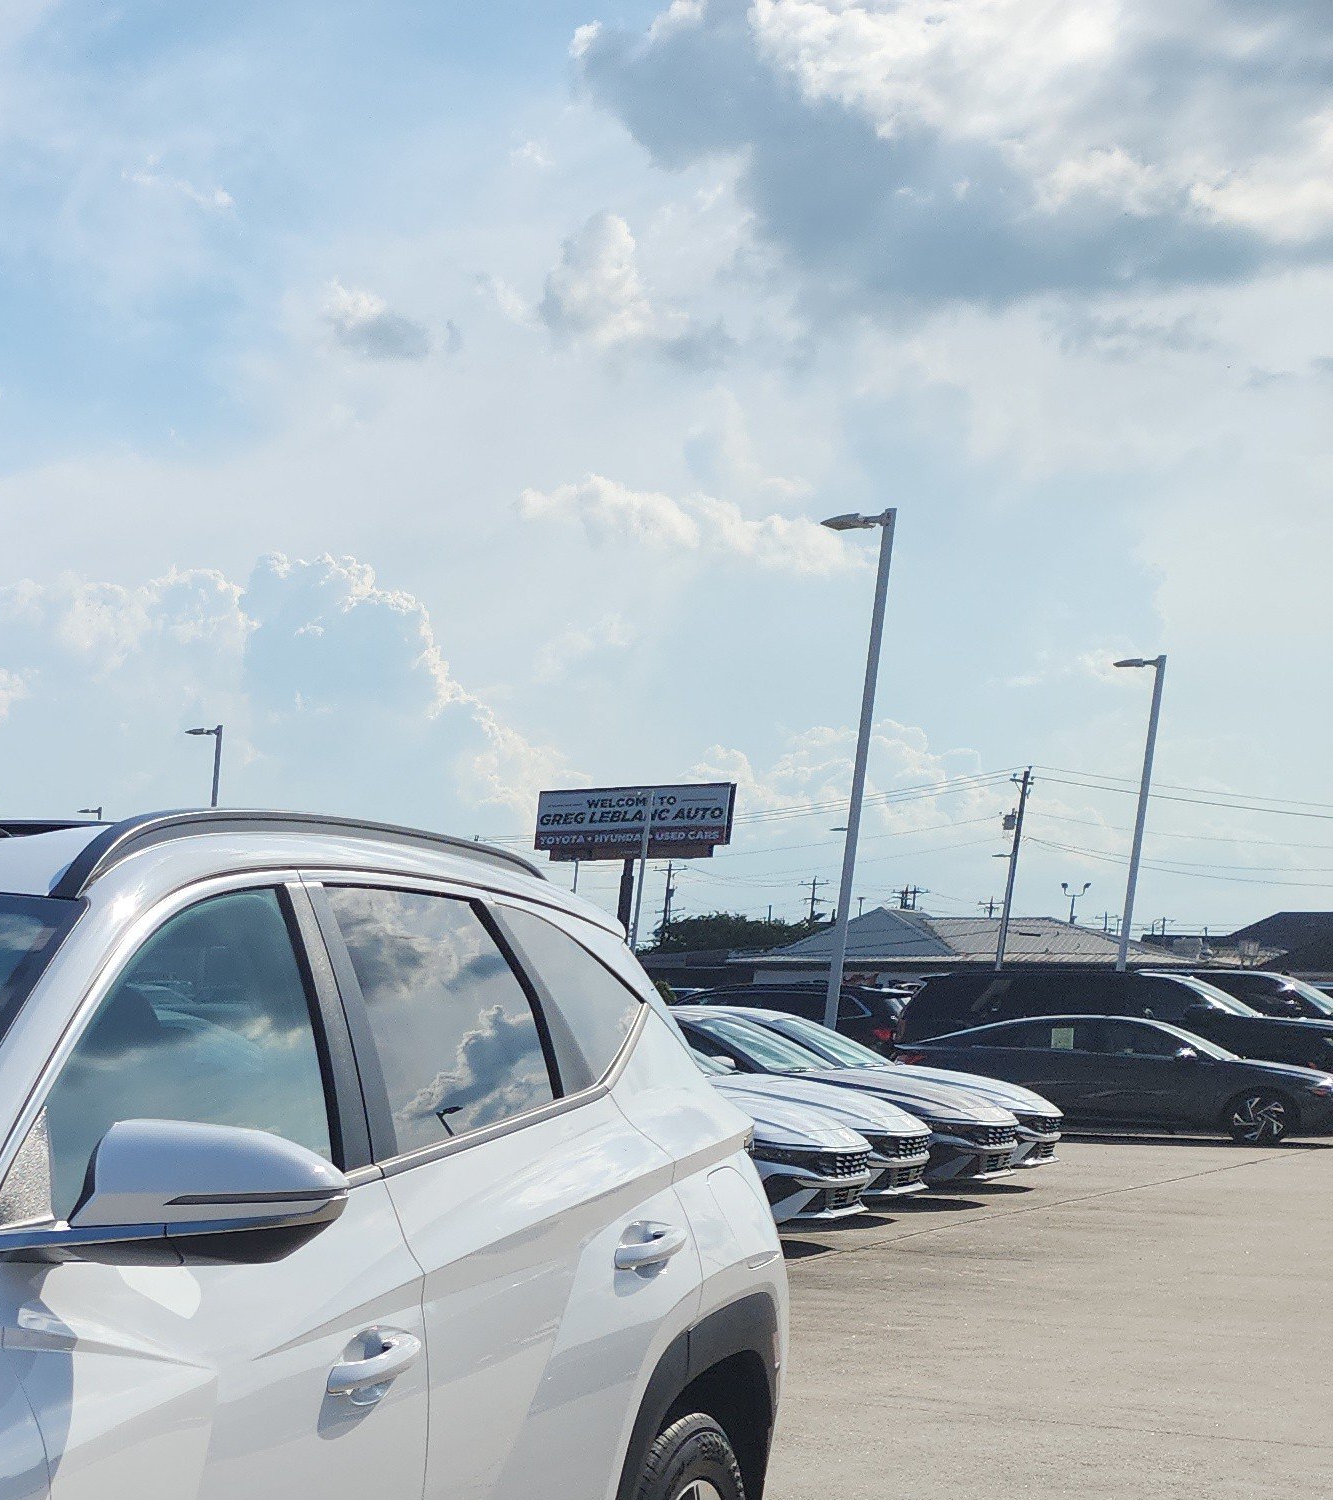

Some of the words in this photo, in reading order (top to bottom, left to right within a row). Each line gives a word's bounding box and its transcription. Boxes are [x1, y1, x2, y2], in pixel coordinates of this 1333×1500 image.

[587, 797, 655, 809] WELCOM
[658, 796, 676, 806] TO
[540, 811, 586, 825] GREG
[672, 807, 723, 821] AUTO
[540, 834, 585, 845] TOYOTA
[594, 833, 645, 843] HYUNDA
[655, 832, 686, 841] USED
[687, 830, 719, 840] CARS
